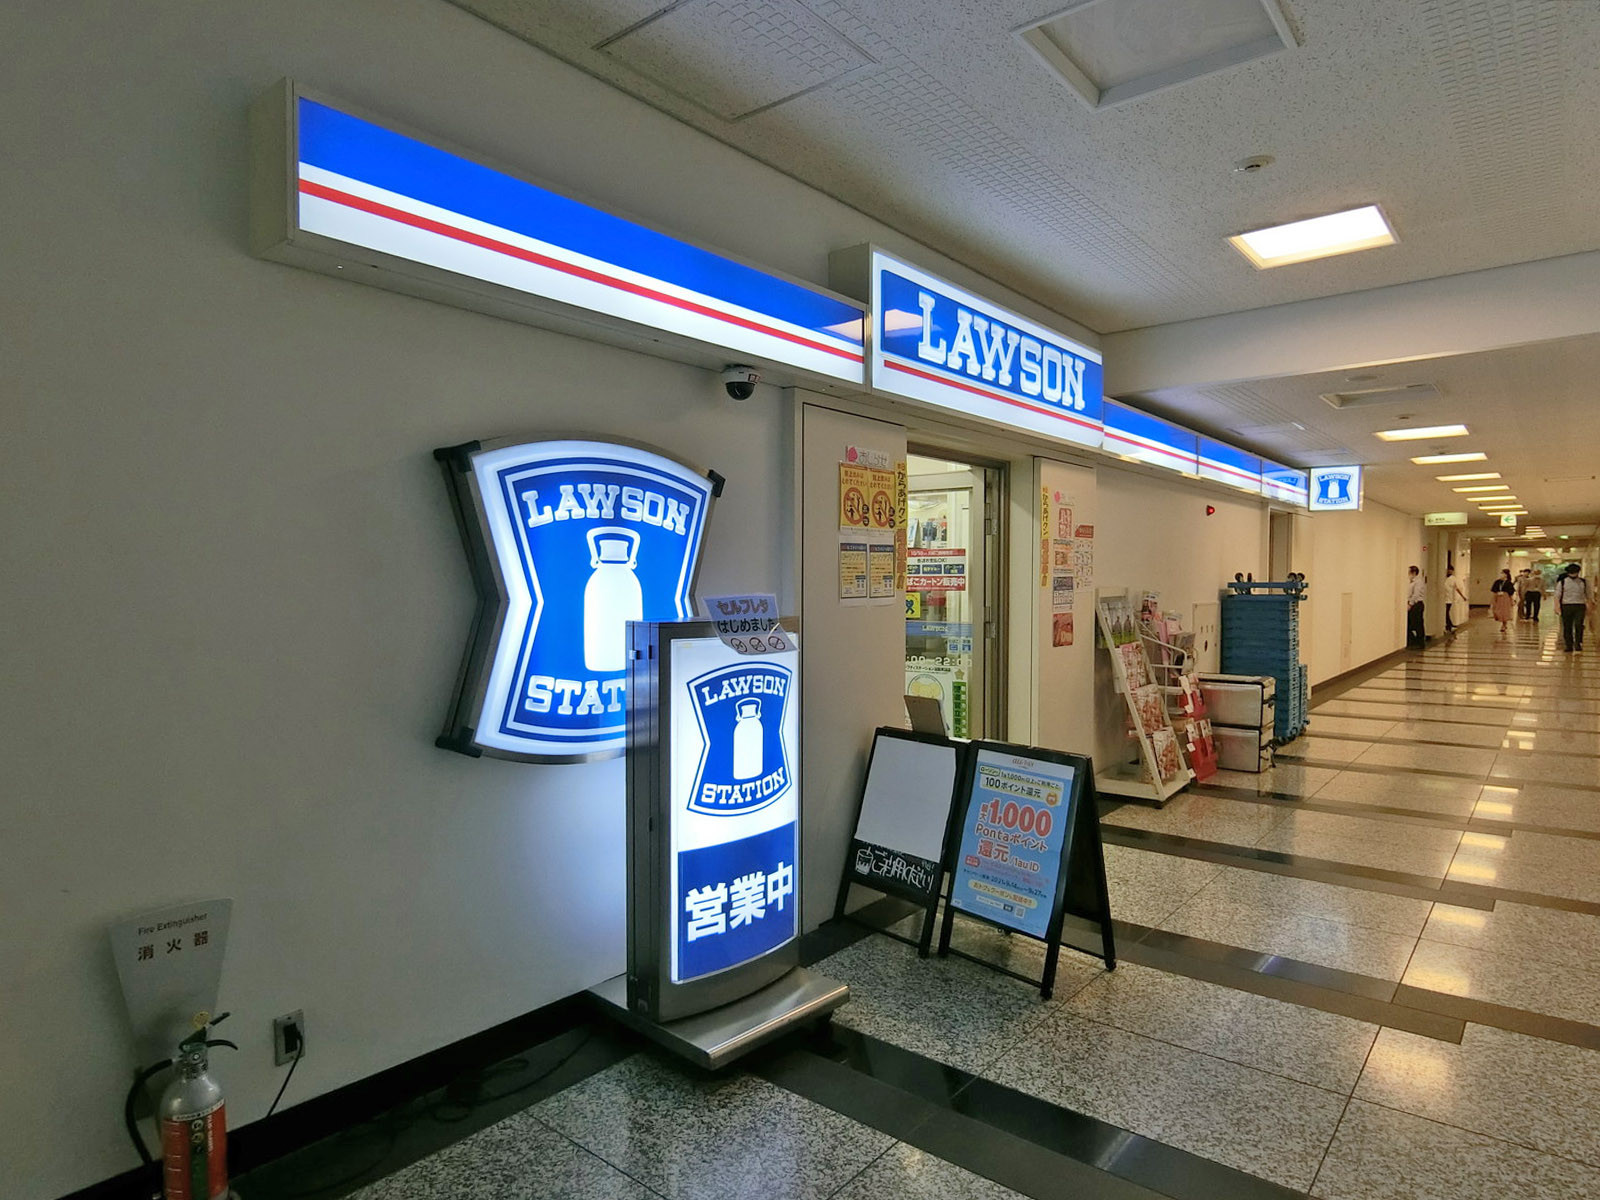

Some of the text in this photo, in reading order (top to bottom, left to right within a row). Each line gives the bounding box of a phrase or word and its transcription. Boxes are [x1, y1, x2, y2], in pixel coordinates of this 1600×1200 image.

[918, 291, 1086, 411] LAWSON
[1318, 474, 1351, 482] LAWSON
[522, 484, 690, 535] LAWSON
[717, 617, 777, 634] はじめました
[701, 674, 786, 706] LAWSON
[701, 767, 785, 804] STATION
[989, 799, 1052, 838] 1,000
[975, 823, 1048, 852] Pontaポイント
[978, 839, 1010, 863] 還元
[685, 861, 793, 942] 営業中
[138, 912, 208, 936] Fire Extinguisher
[138, 931, 209, 961] 消火器
